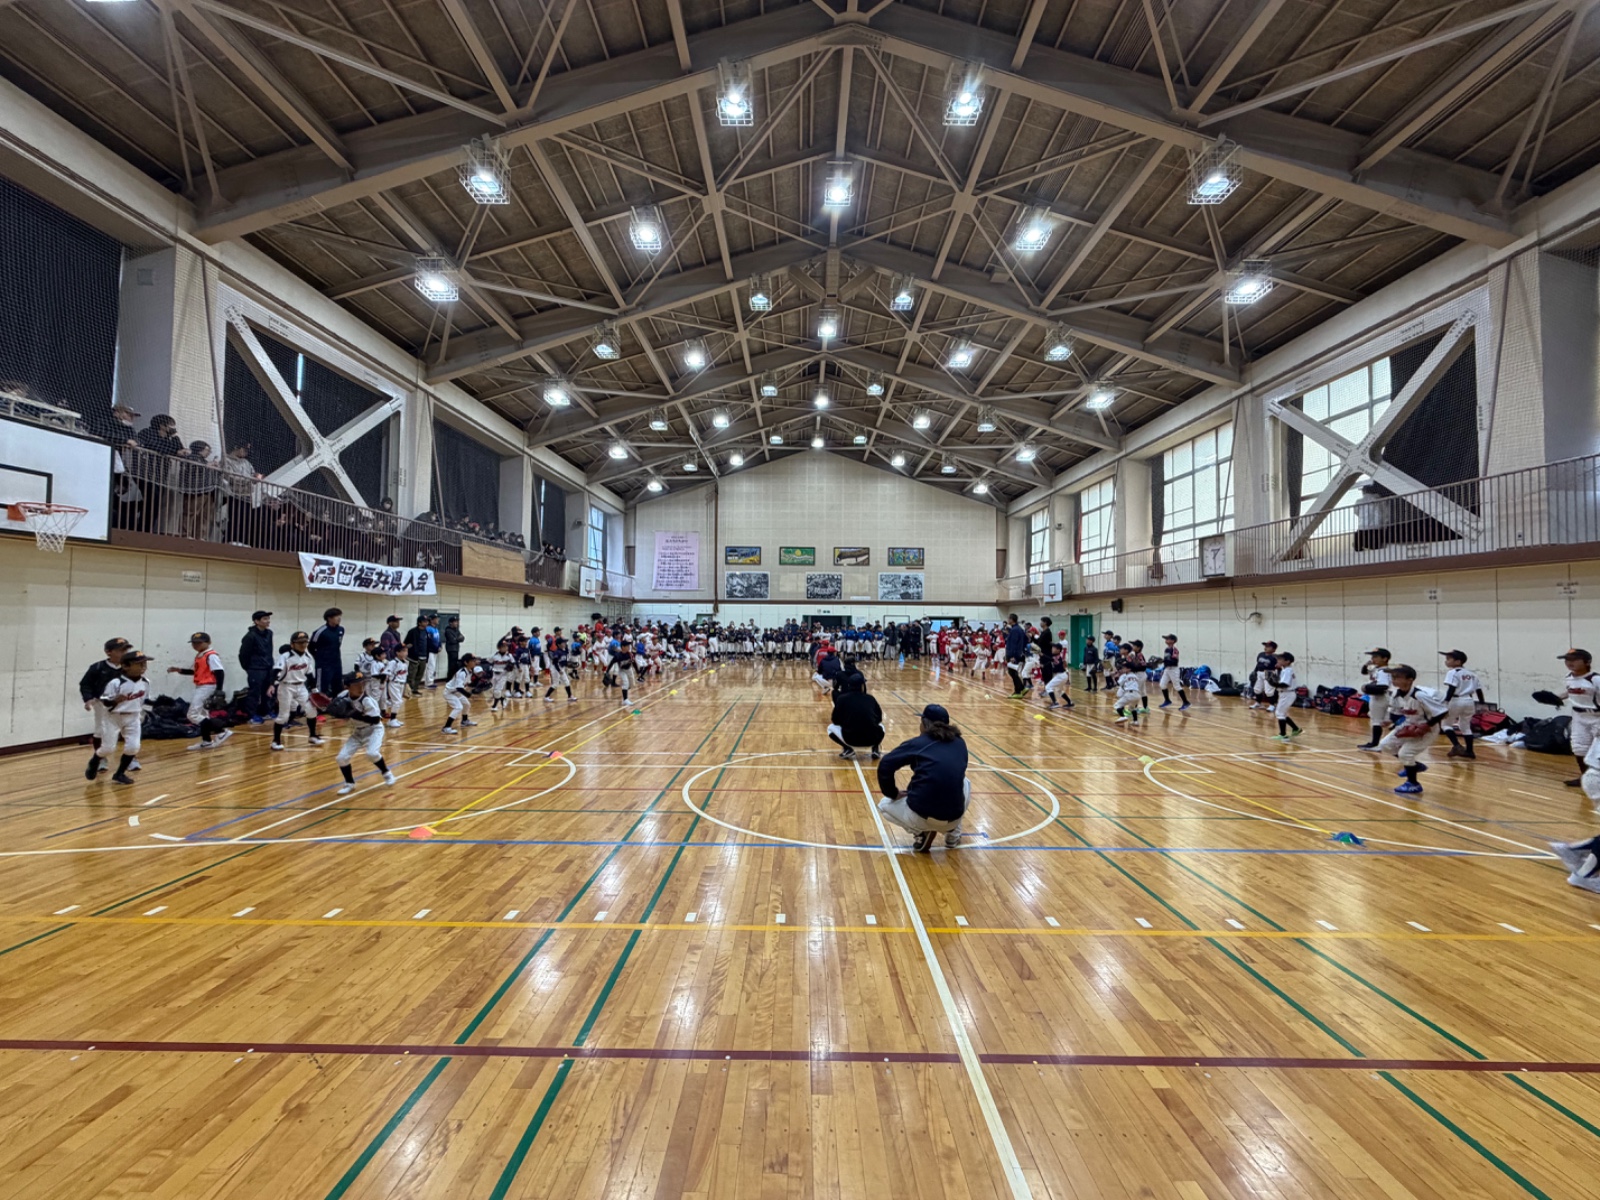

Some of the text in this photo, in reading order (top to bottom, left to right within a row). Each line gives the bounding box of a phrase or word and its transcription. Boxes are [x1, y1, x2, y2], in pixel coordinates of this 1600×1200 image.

[353, 565, 428, 591] 福井県人会
